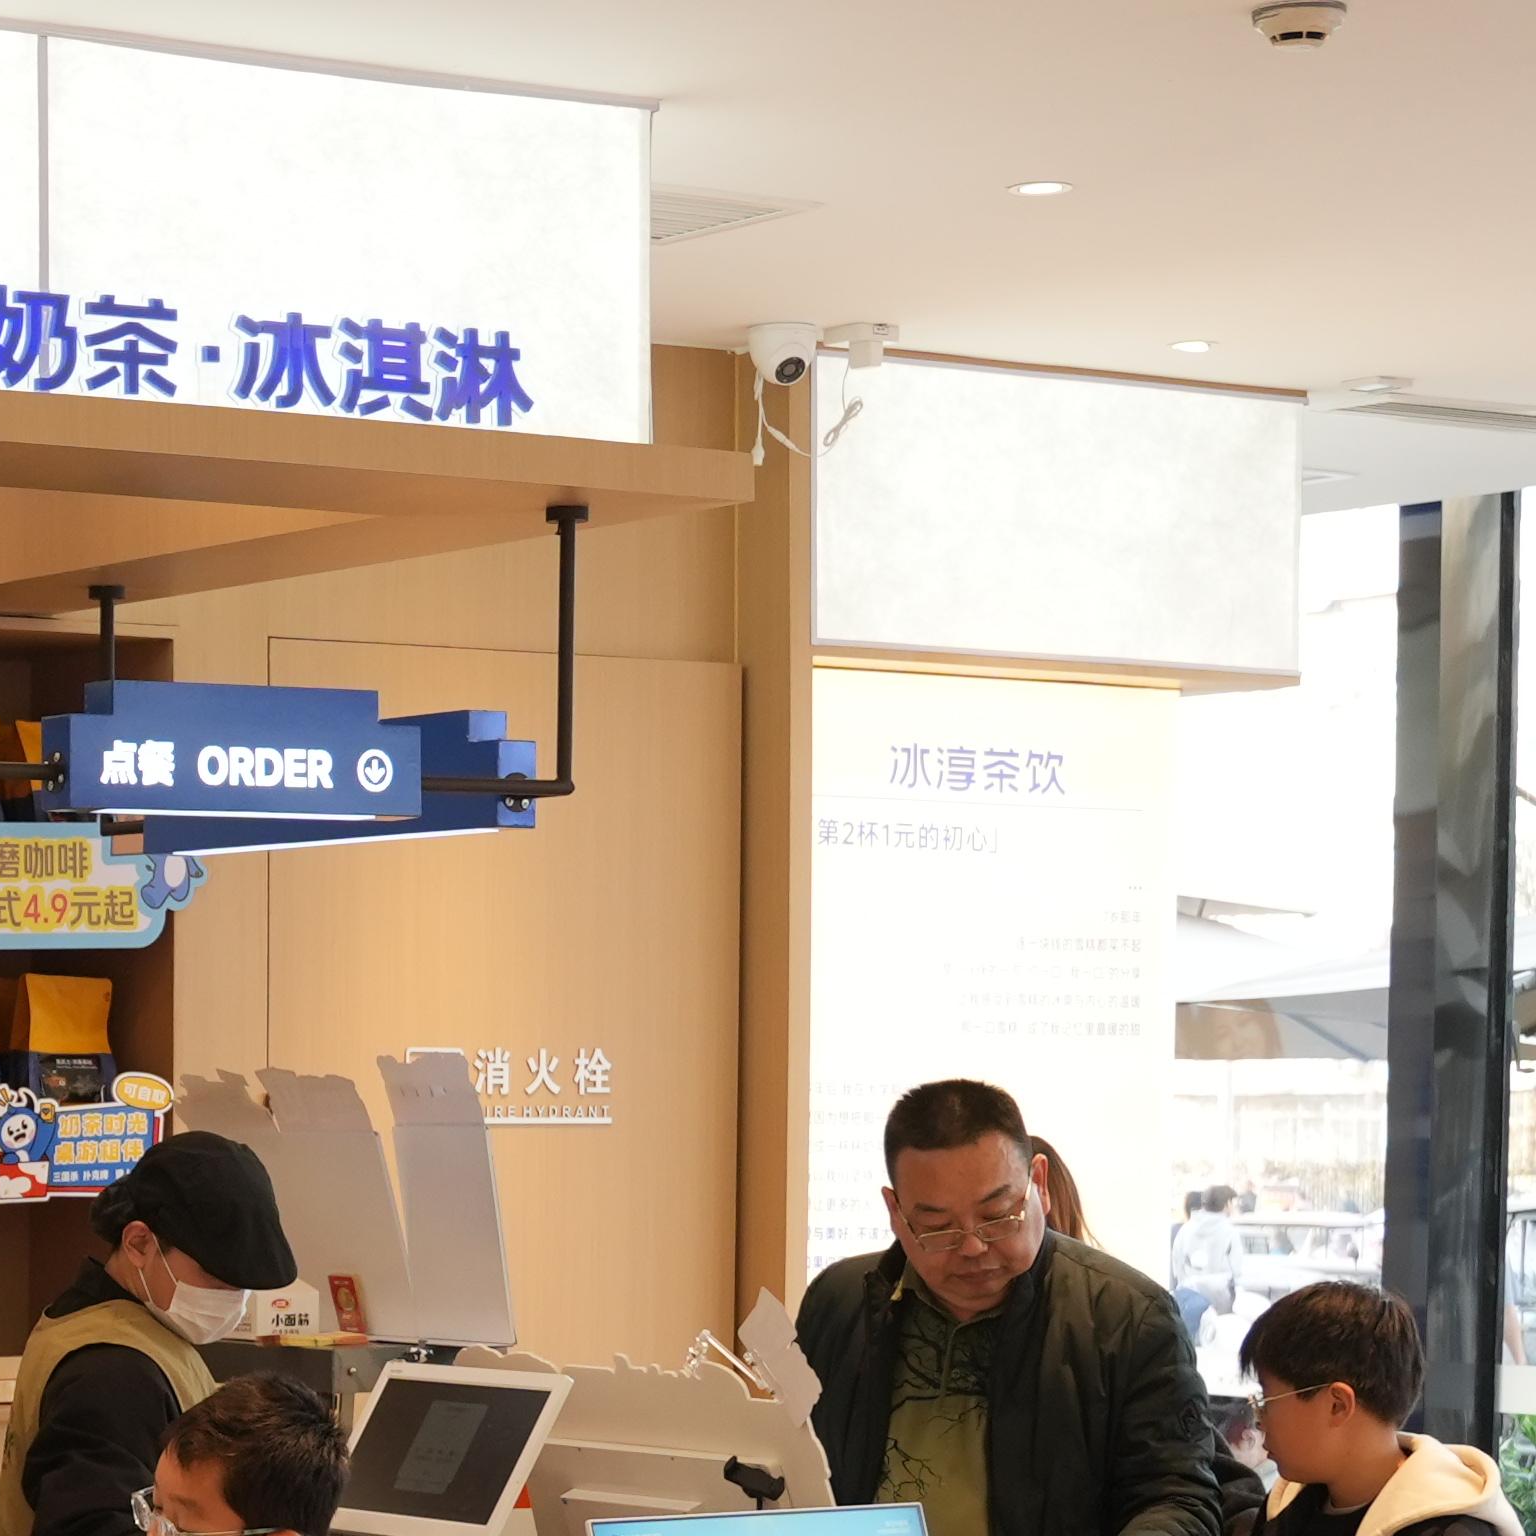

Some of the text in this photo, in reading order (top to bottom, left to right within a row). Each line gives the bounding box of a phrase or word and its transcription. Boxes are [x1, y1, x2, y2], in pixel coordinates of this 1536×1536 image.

[100, 739, 333, 790] 点餐 ORDER
[889, 743, 1066, 795] 冰淳茶饮
[473, 1047, 612, 1095] 消火栓
[58, 1112, 148, 1138] 奶茶时光
[485, 1105, 610, 1118] IRE HYDRANT
[54, 1139, 144, 1165] 桌游相伴
